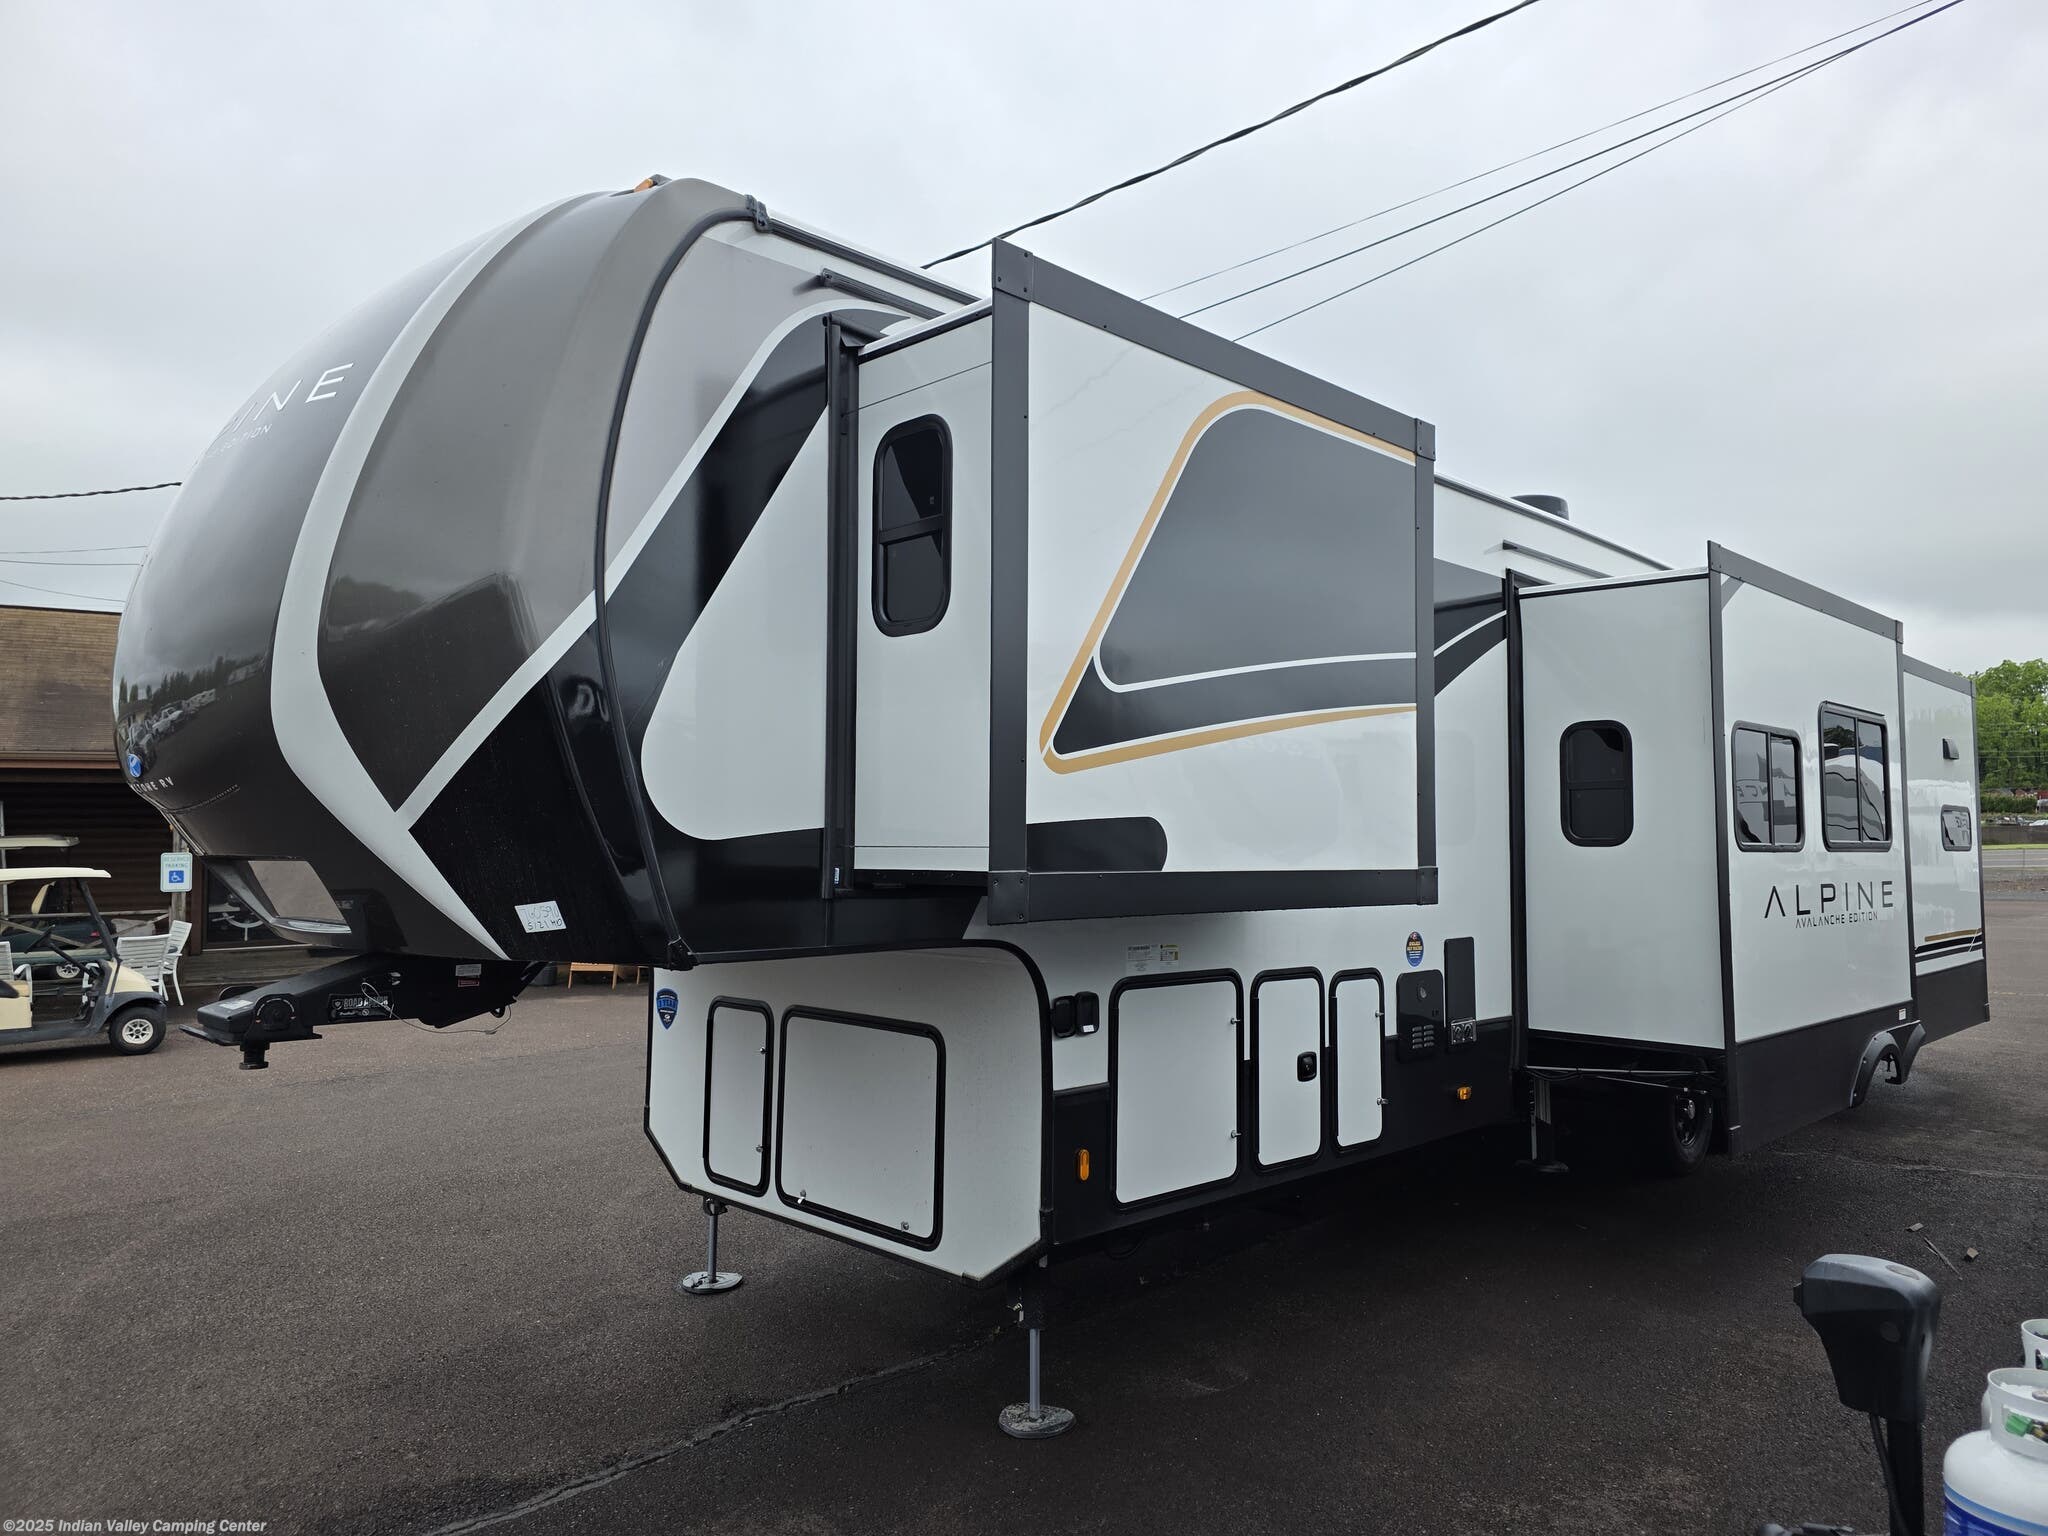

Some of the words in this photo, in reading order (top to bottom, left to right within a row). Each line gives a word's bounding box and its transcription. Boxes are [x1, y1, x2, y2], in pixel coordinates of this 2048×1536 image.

[158, 776, 174, 788] RV
[1764, 880, 1894, 919] ALPINE
[1795, 913, 1846, 929] AVALANCHE
[1848, 911, 1879, 923] EDITION
